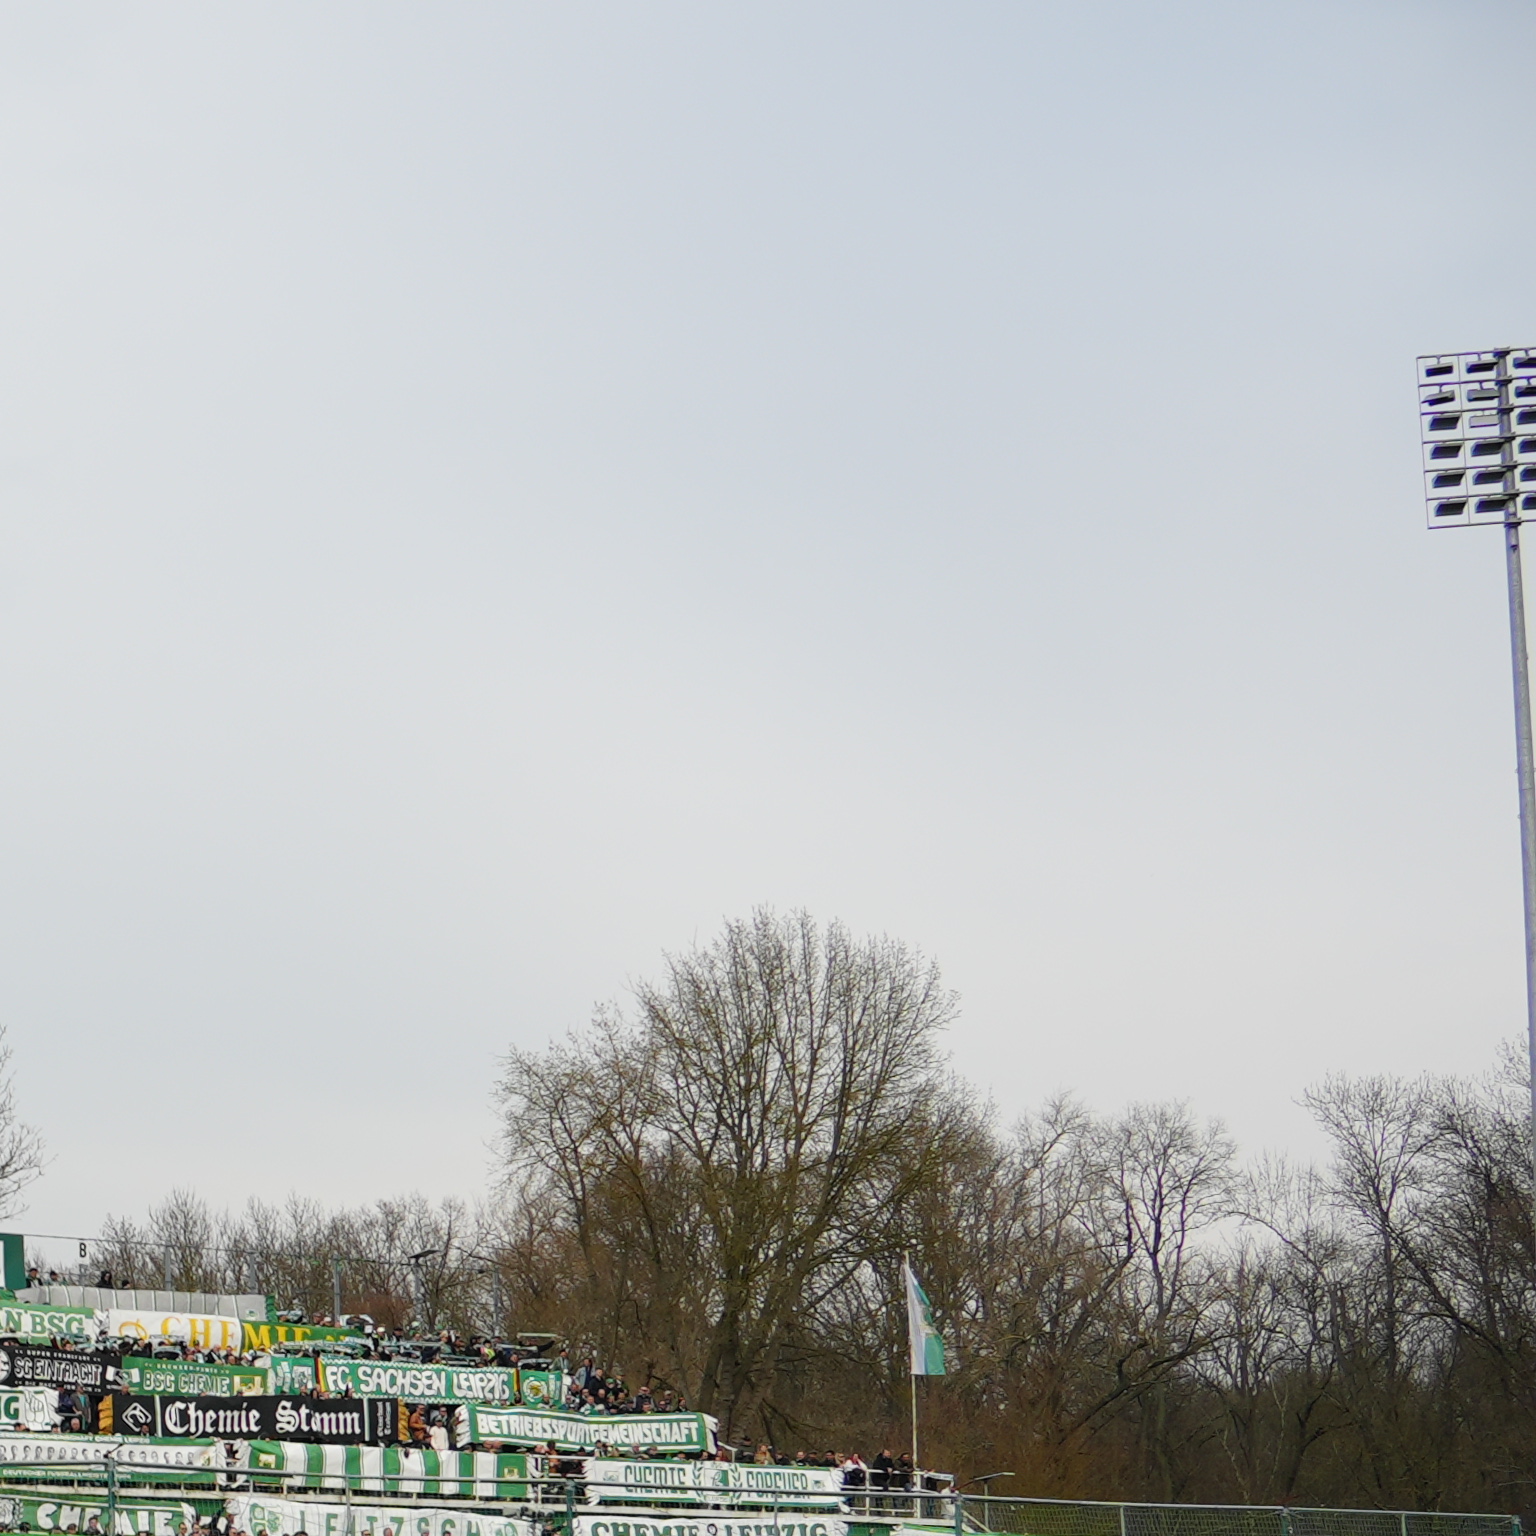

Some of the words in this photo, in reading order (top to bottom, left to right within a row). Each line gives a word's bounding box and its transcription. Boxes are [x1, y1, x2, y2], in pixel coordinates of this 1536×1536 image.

[79, 1242, 87, 1258] B
[27, 1311, 86, 1337] BSG
[34, 1358, 102, 1386] EINTRACHT
[143, 1369, 174, 1392] BSG
[178, 1373, 230, 1397] CHEMIE
[356, 1369, 446, 1397] SACHSEN
[452, 1371, 510, 1400] LEIPZIG
[164, 1400, 261, 1438] Chemie
[275, 1400, 362, 1436] Stamm
[478, 1411, 699, 1445] BETRIEBSSPORTGEMEINSCHAFT
